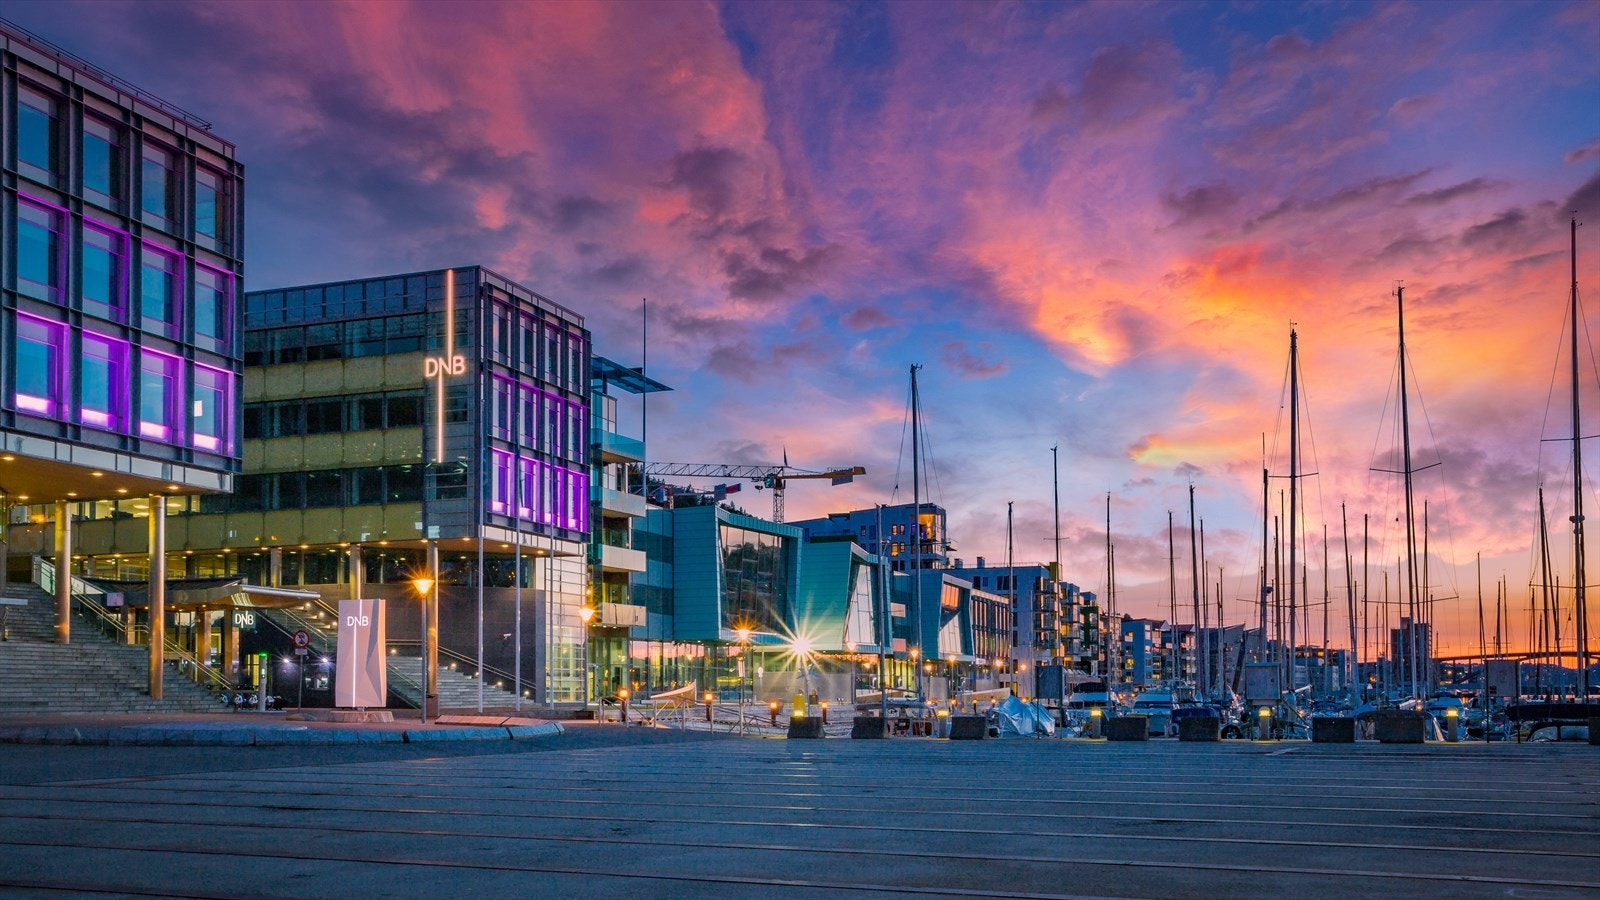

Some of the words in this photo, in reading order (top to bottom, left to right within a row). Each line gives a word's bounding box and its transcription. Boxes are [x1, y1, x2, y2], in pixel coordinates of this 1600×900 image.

[425, 355, 466, 378] DNB
[234, 611, 254, 628] DNB
[347, 615, 369, 627] DNB
